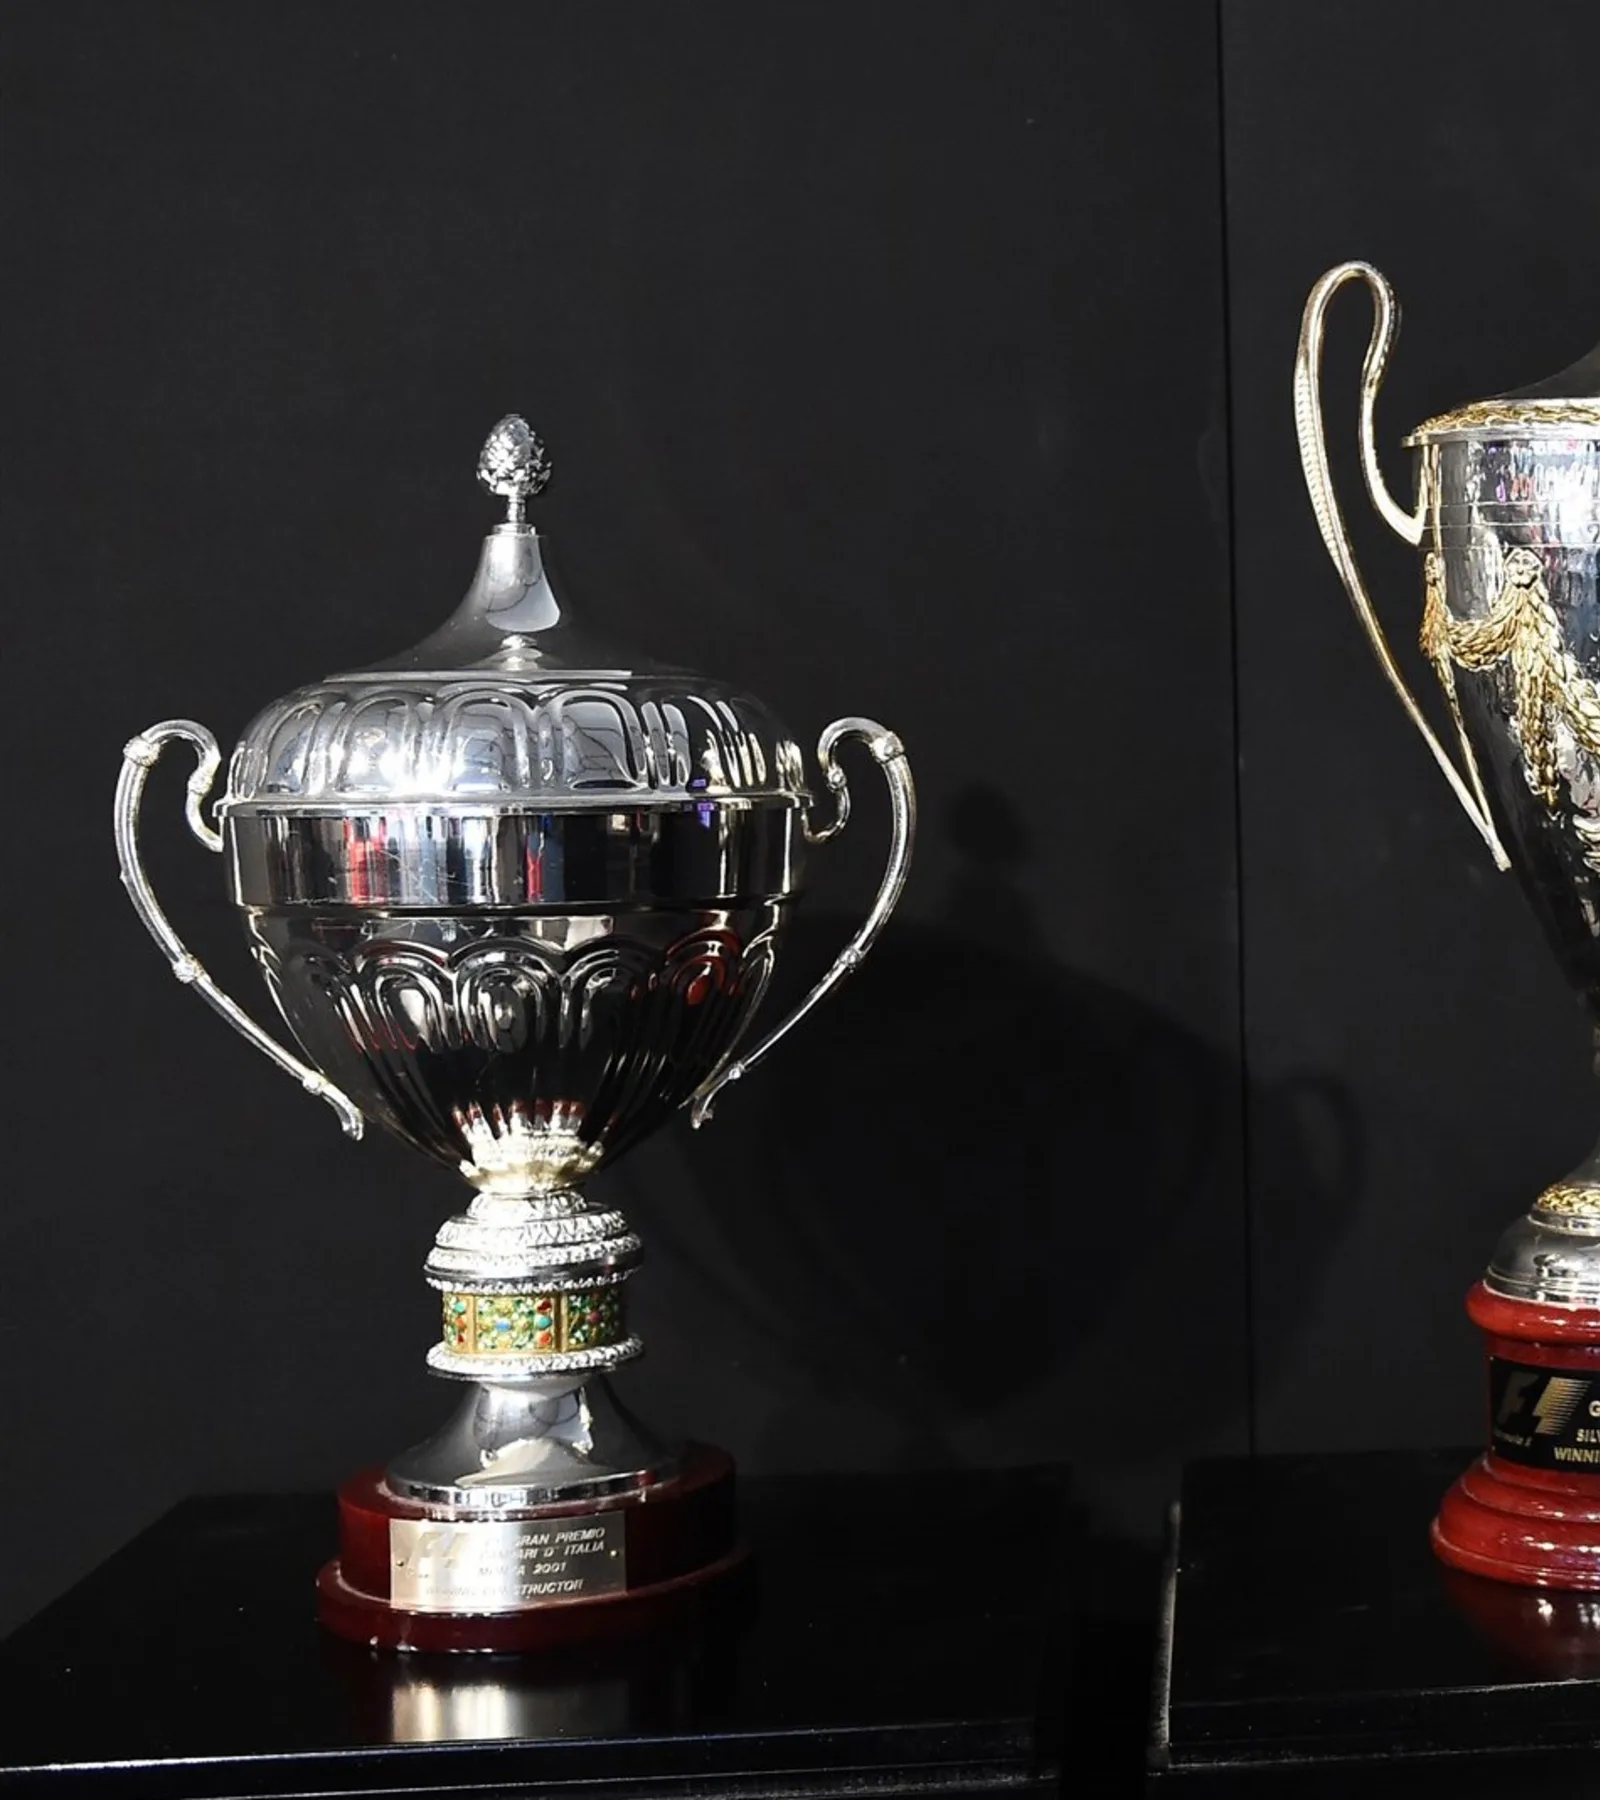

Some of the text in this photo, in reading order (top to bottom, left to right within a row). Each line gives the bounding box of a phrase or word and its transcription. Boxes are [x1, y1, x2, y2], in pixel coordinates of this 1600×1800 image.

[555, 1527, 606, 1543] PREMIO
[564, 1541, 605, 1556] ITALIA
[532, 1562, 567, 1574] 2001
